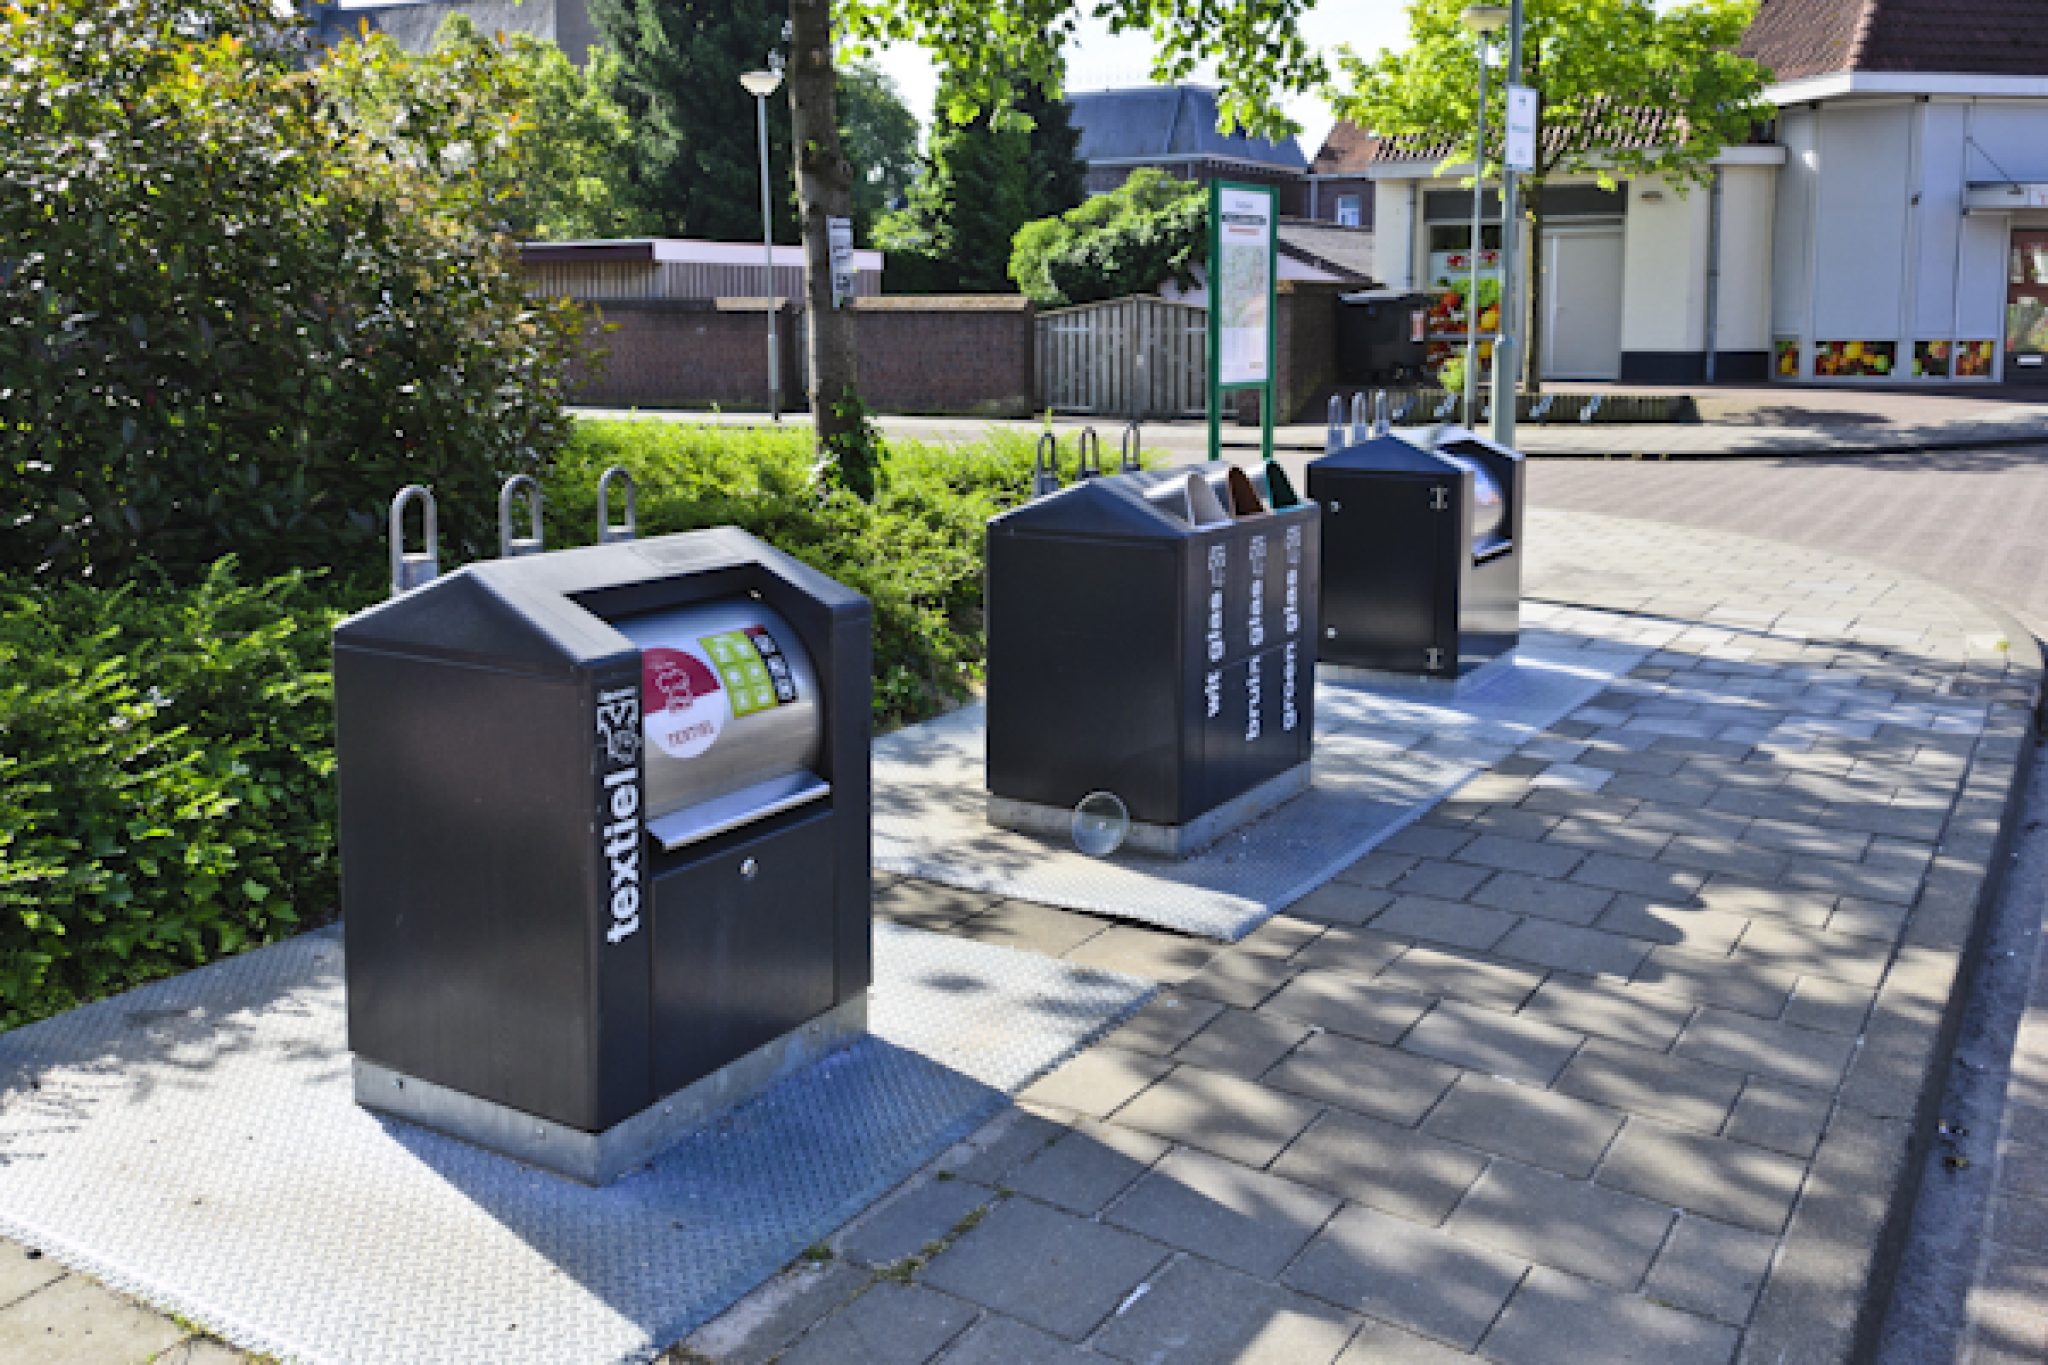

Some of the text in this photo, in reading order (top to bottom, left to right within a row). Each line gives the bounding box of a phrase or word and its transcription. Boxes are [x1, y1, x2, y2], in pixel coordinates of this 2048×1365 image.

[1205, 591, 1223, 717] wit glas
[1246, 579, 1263, 741] bruin glas
[1283, 569, 1298, 730] groen glas
[604, 769, 640, 942] textiel
